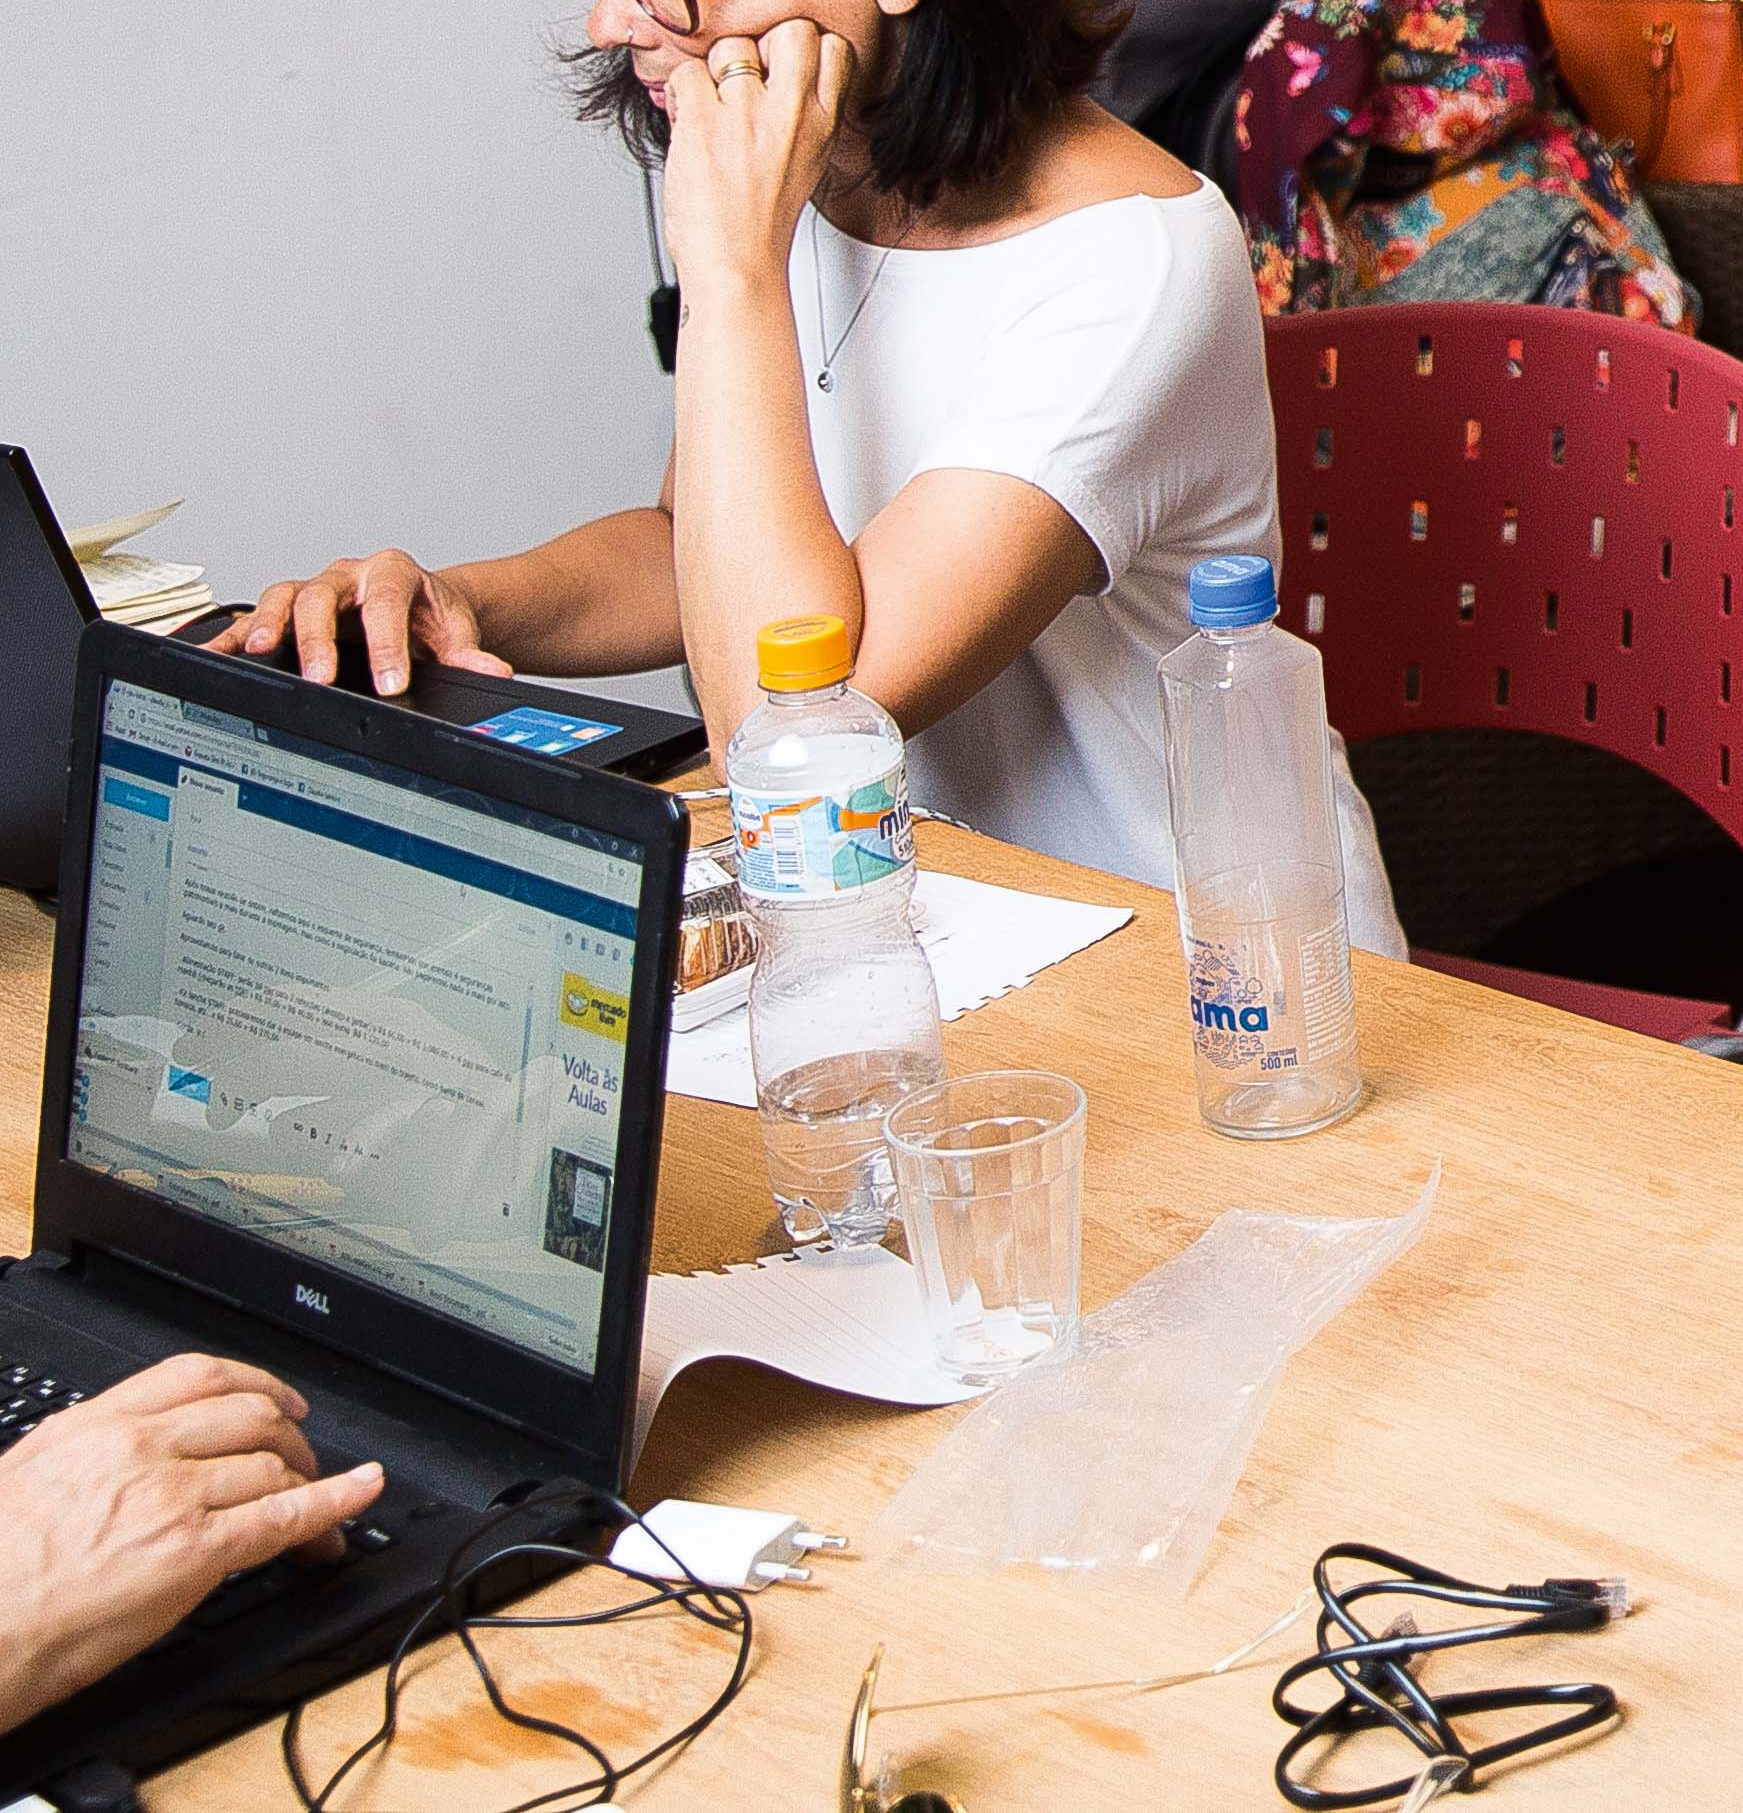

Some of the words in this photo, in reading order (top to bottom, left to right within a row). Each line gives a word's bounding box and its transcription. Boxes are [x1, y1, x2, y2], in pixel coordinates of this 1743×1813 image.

[563, 1053, 599, 1088] Volta
[602, 1068, 619, 1093] às
[1260, 1056, 1281, 1071] 500
[1283, 1054, 1299, 1067] ml
[567, 1082, 608, 1117] Aulas
[295, 1284, 330, 1315] DELL
